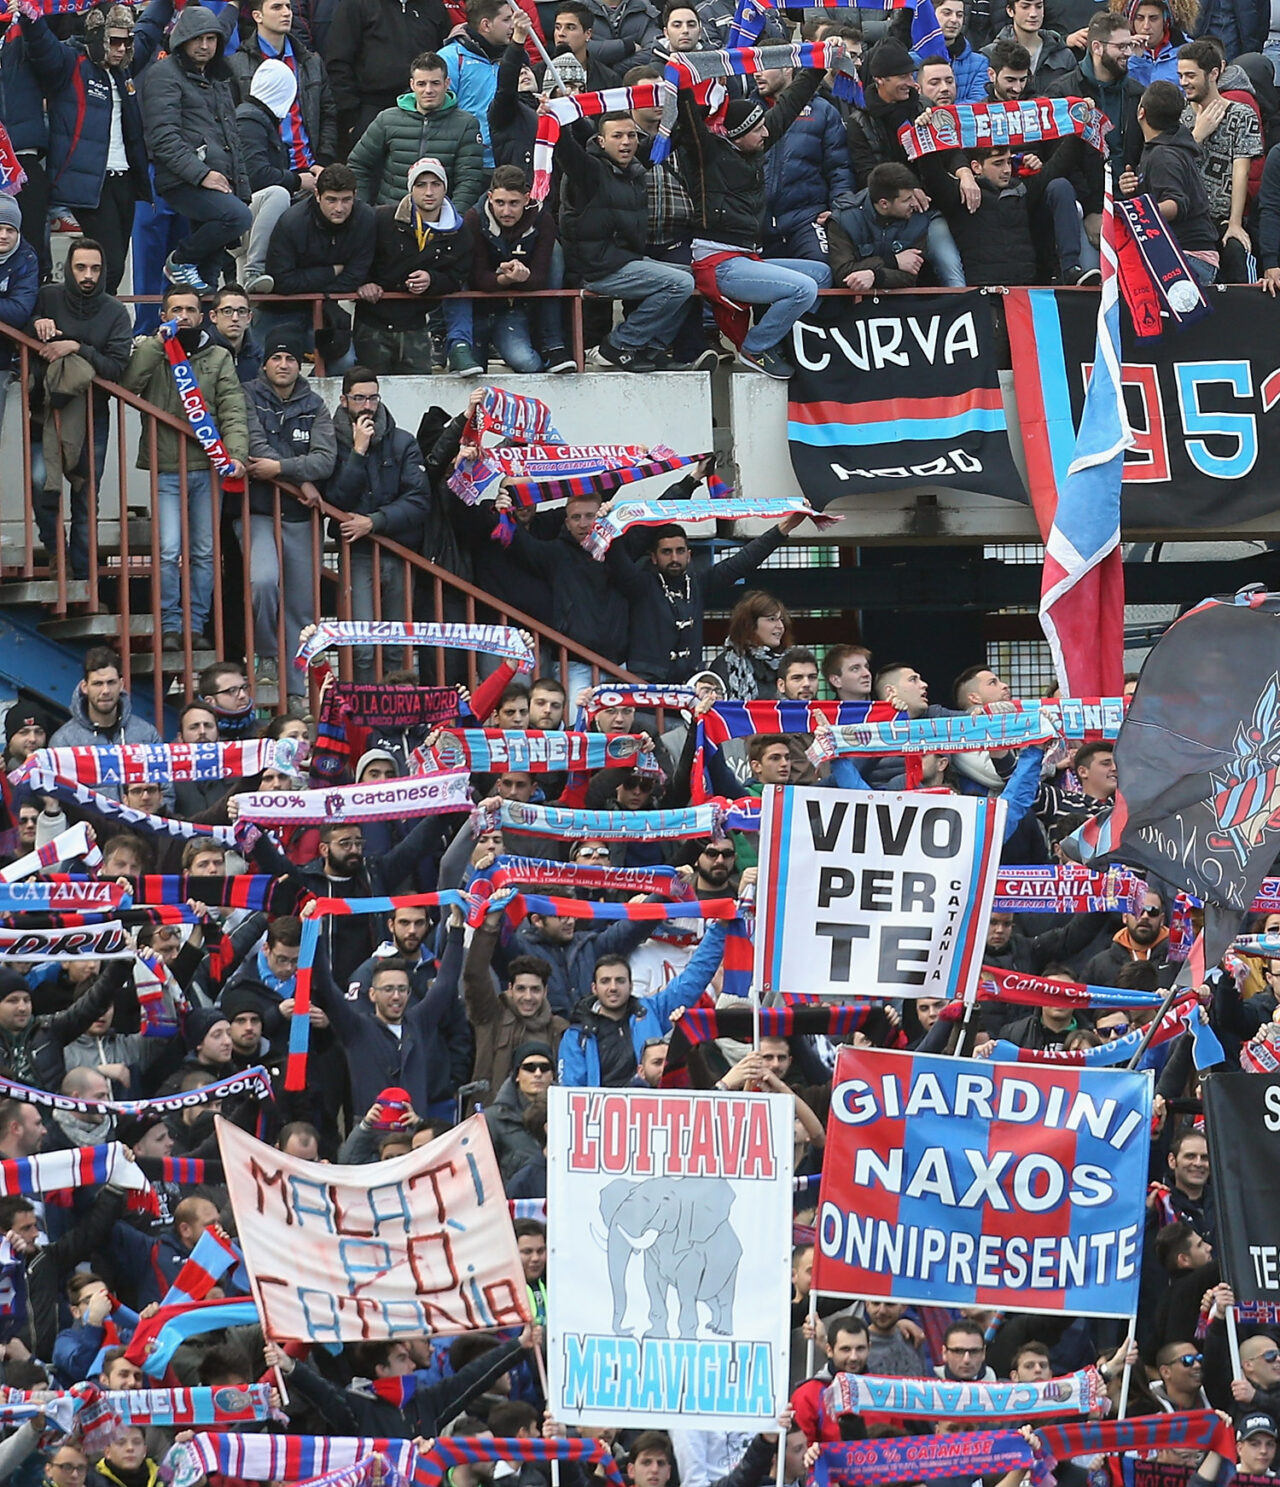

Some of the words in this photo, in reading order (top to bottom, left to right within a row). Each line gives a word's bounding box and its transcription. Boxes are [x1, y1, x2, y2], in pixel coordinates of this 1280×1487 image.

[975, 106, 1053, 138] ETNEI
[793, 311, 980, 371] CURVA
[173, 365, 207, 423] CALCIO
[484, 387, 553, 430] CATANI
[490, 445, 547, 462] FORZA
[556, 444, 629, 460] CATANIA
[380, 693, 421, 713] CURVA
[424, 690, 458, 712] NORD
[1042, 704, 1123, 730] ETNE
[489, 736, 581, 763] ETNEI
[102, 765, 232, 782] Arrivando
[249, 795, 307, 809] 100%
[351, 784, 439, 806] catanese
[806, 800, 962, 859] VIVO
[9, 882, 111, 902] CATANIA
[817, 866, 937, 913] PER
[1005, 880, 1094, 896] CATANIA
[931, 879, 962, 981] CATANIA
[815, 922, 932, 985] TE
[154, 1093, 207, 1113] TUOI
[831, 1073, 1142, 1151] GIARDINI
[567, 1093, 777, 1180] L'OTTAVA
[854, 1145, 1114, 1212] NAXOS
[819, 1205, 1139, 1290] ONNIPRESENTE
[562, 1333, 773, 1417] MERAVIGLIA
[107, 1387, 187, 1414] TNEI
[867, 1381, 1039, 1412] CATANIA
[846, 1451, 878, 1466] 100
[883, 1448, 901, 1461] %
[907, 1440, 995, 1460] CATANESE
